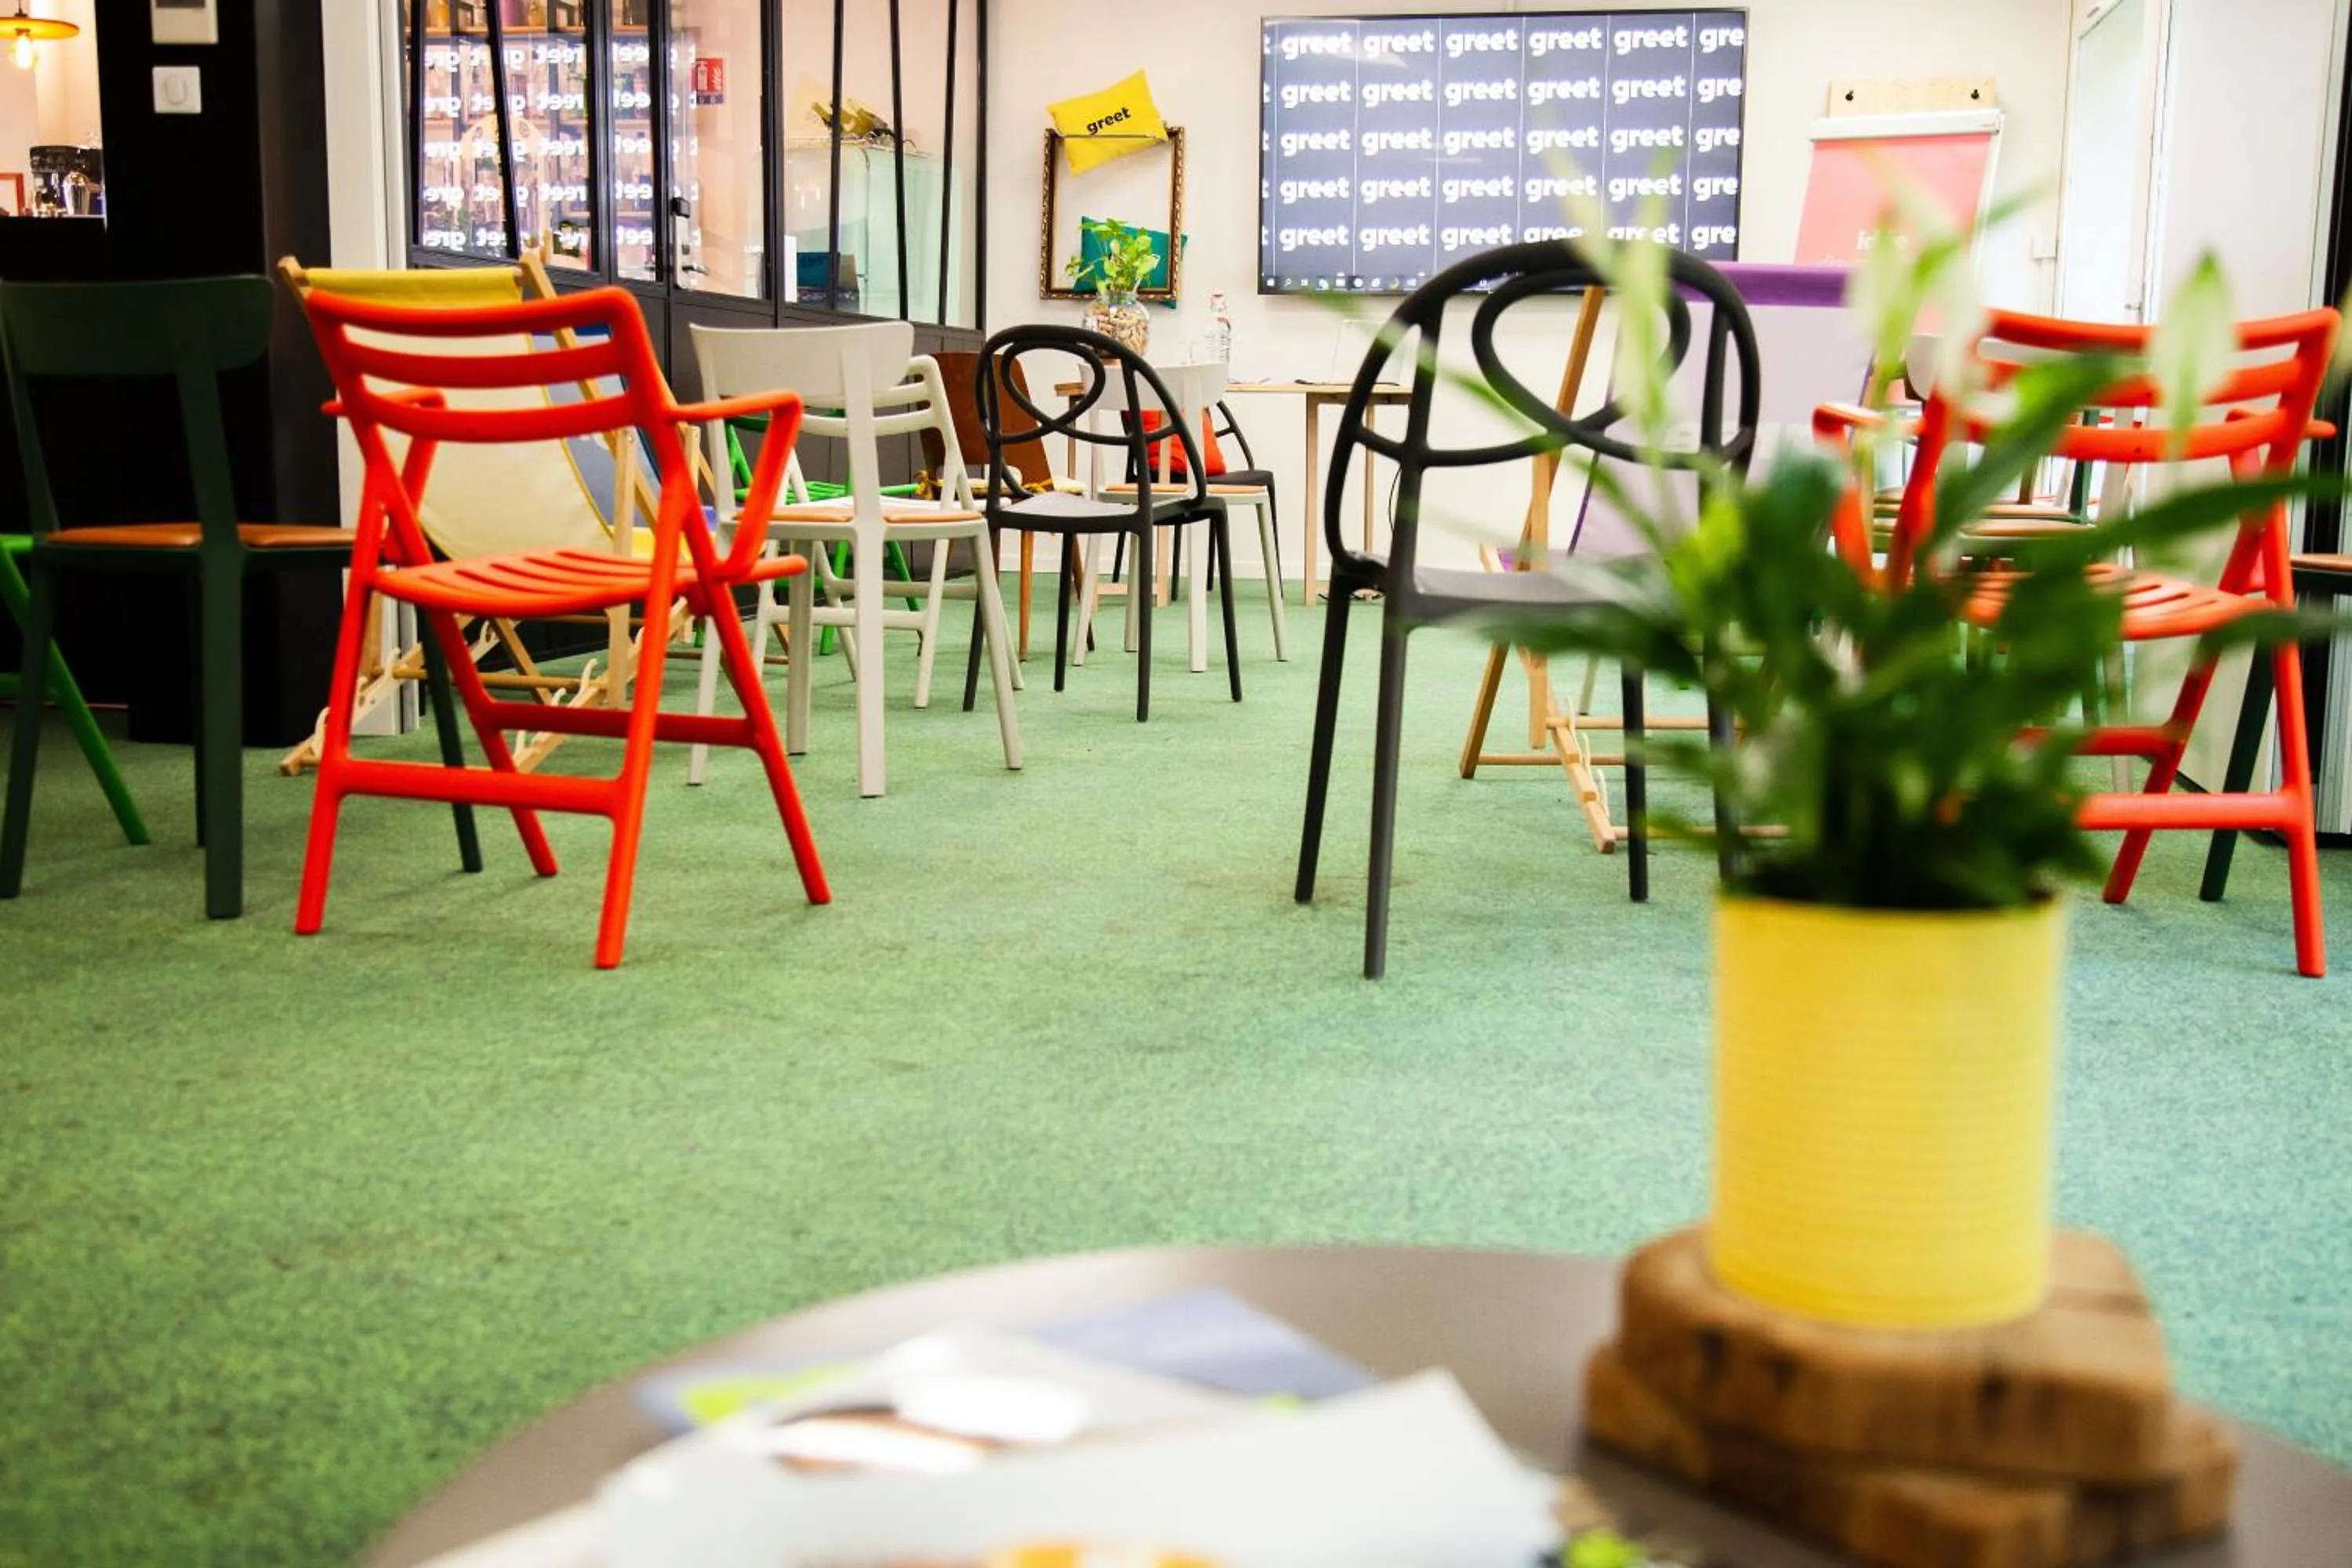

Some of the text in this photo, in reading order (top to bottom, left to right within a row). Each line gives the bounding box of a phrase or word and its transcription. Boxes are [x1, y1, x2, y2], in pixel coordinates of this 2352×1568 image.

[1281, 32, 1352, 60] greet
[1363, 31, 1434, 59] greet
[1446, 30, 1518, 58] greet
[1529, 28, 1602, 56] greet
[1613, 27, 1687, 55] greet
[1281, 80, 1351, 108] greet
[1362, 79, 1433, 107] greet
[1444, 78, 1516, 107] greet
[1527, 77, 1600, 106] greet
[1612, 76, 1686, 104] greet
[1087, 107, 1131, 136] greet
[1280, 129, 1351, 156] greet
[1361, 128, 1432, 156] greet
[1443, 127, 1515, 155] greet
[1526, 126, 1599, 154] greet
[1610, 125, 1683, 153] greet
[1279, 176, 1349, 204] greet
[1360, 176, 1431, 204] greet
[1442, 176, 1514, 203] greet
[1525, 175, 1597, 203] greet
[1608, 174, 1682, 202] greet
[1279, 225, 1348, 252] greet
[1359, 224, 1430, 252] greet
[1441, 223, 1512, 252] greet
